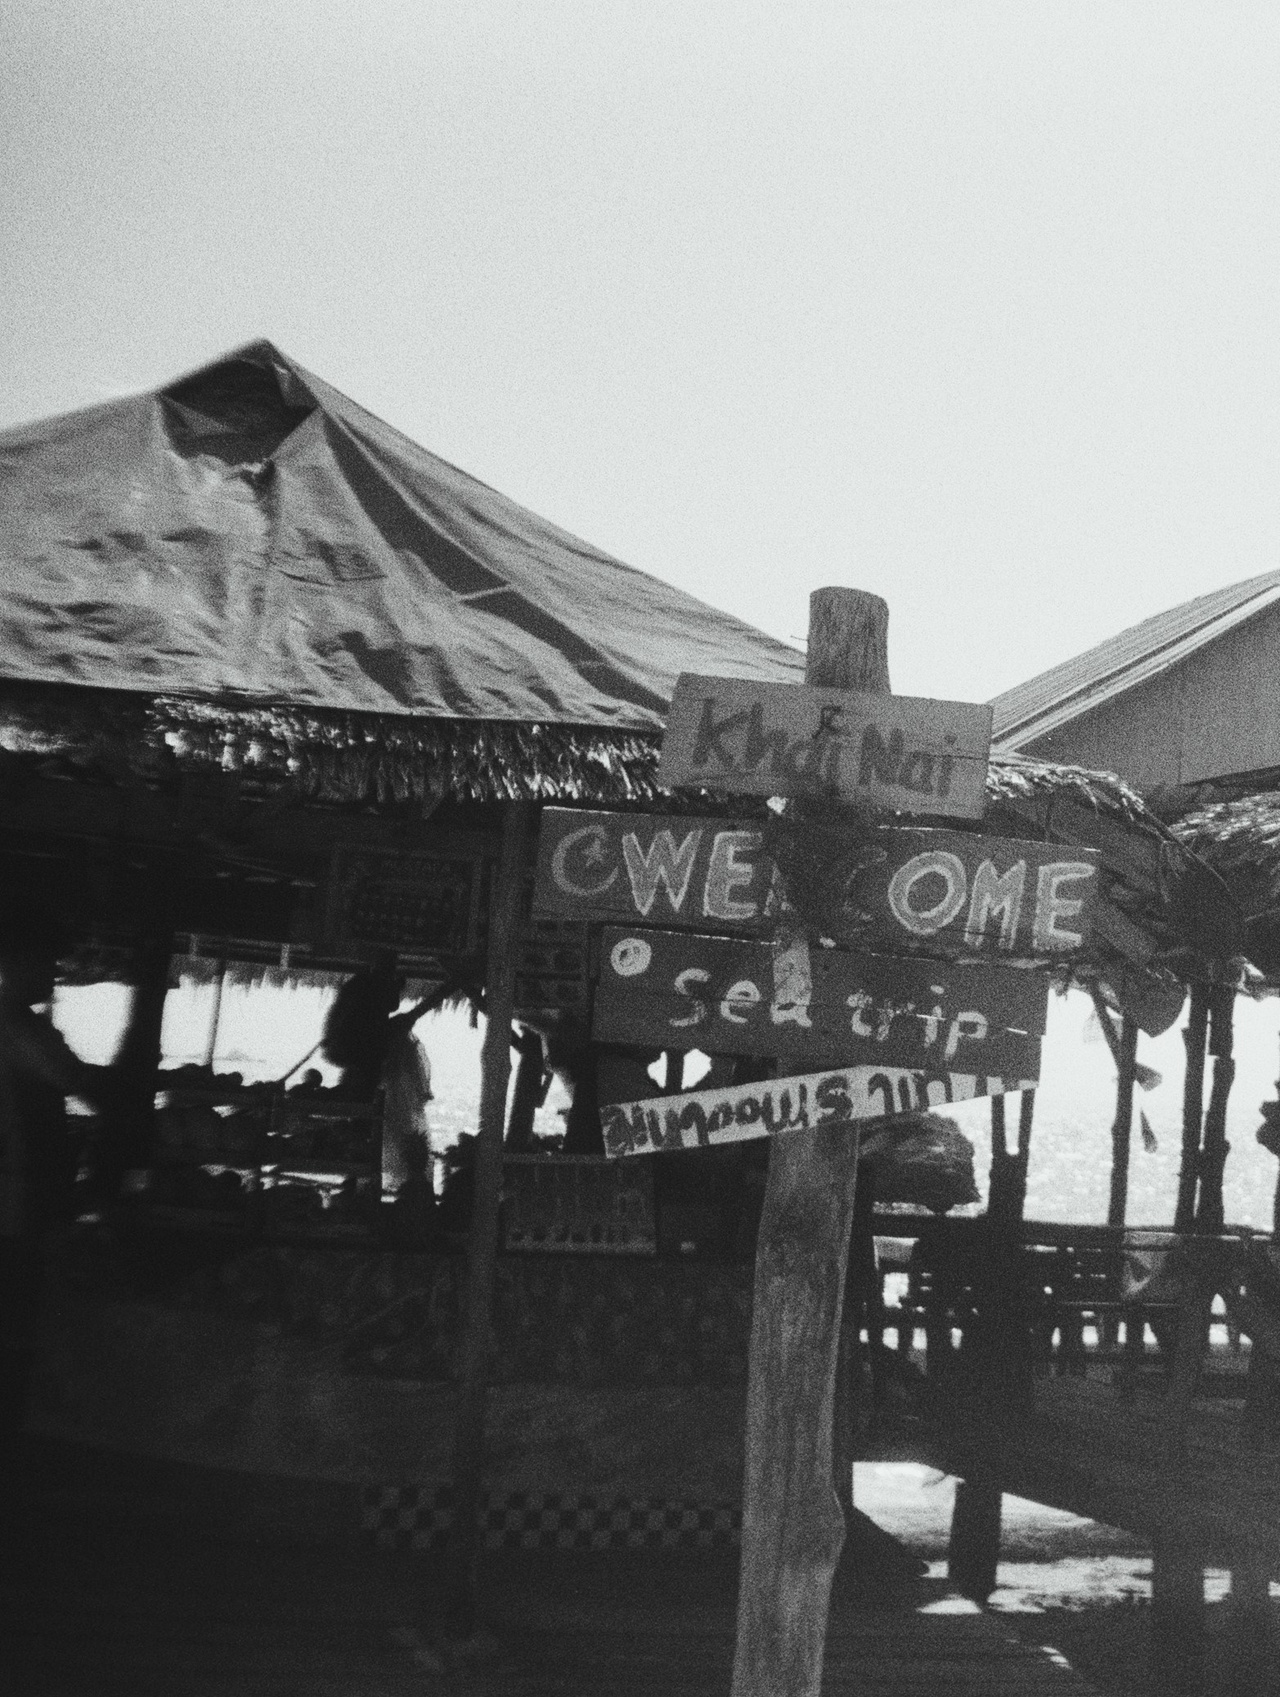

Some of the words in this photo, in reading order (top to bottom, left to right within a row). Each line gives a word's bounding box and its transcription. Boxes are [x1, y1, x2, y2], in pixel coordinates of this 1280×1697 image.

[692, 698, 843, 786] Khai
[858, 721, 958, 798] Nai
[621, 829, 1097, 950] WECOME
[845, 984, 989, 1061] trip
